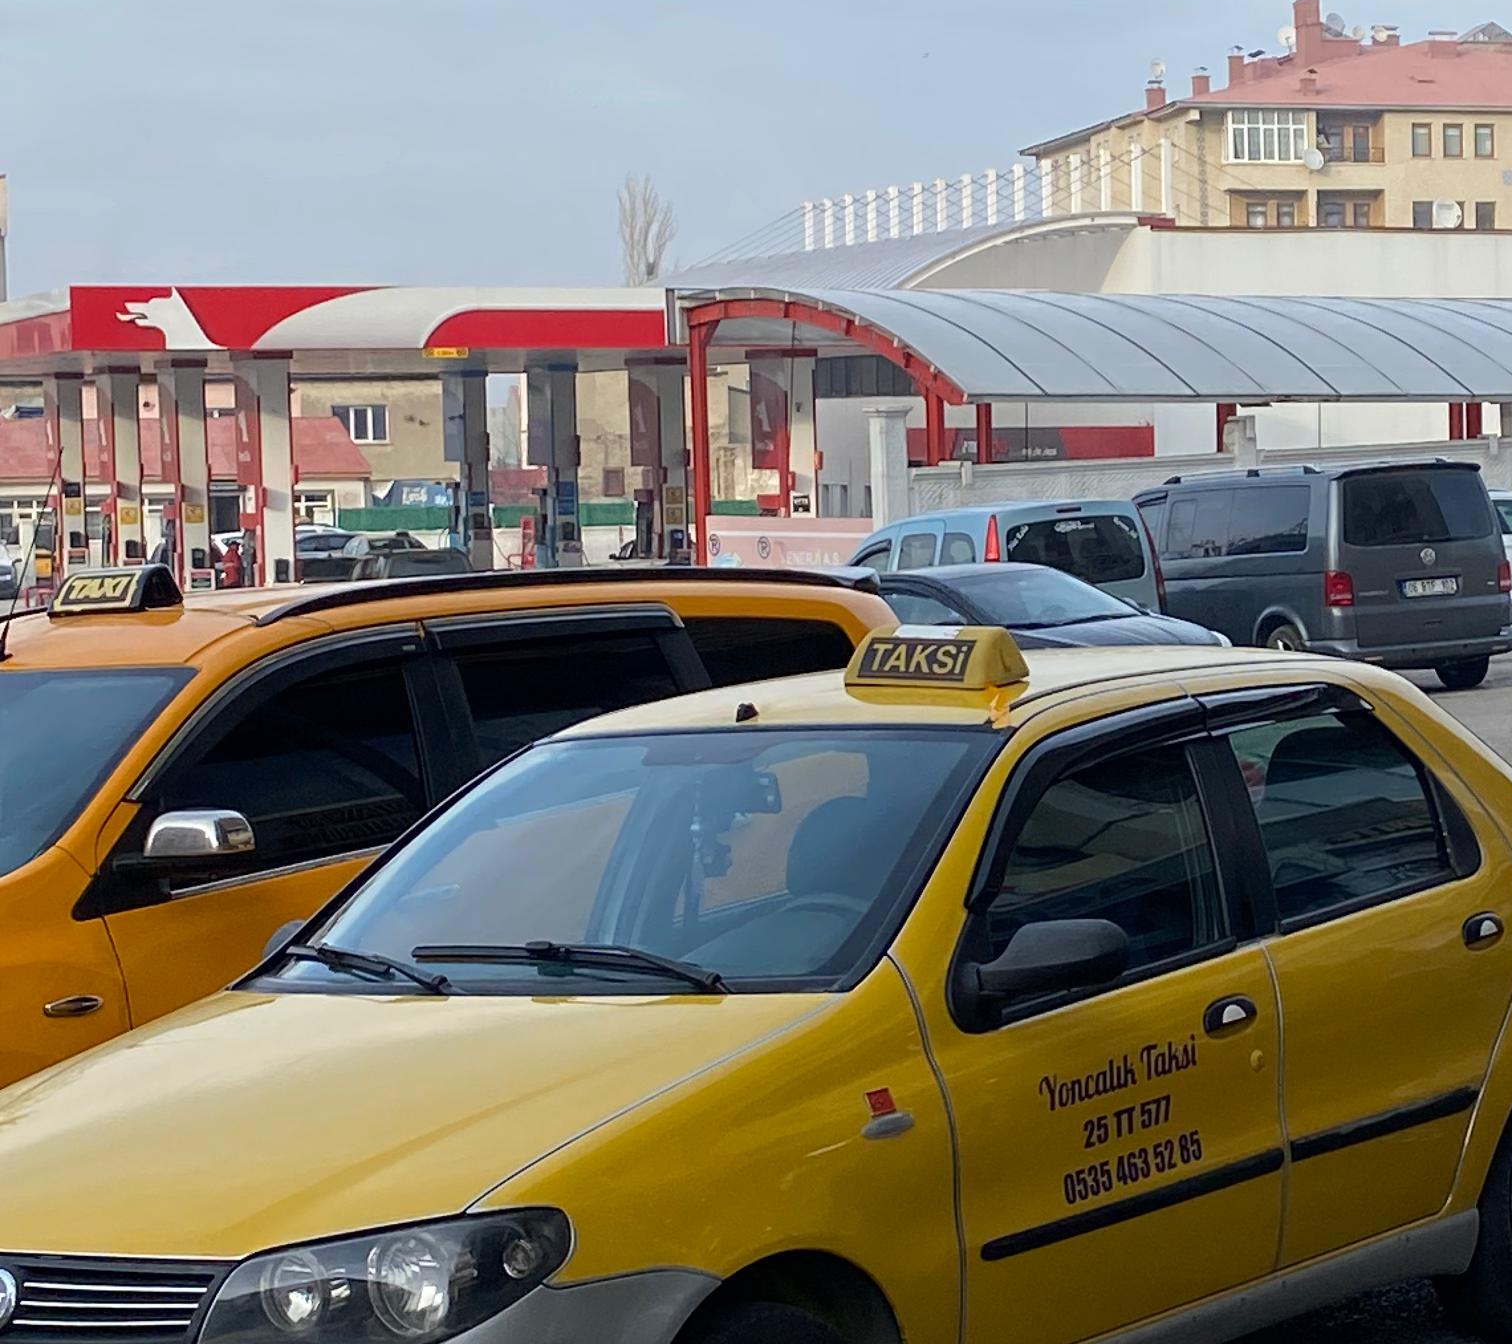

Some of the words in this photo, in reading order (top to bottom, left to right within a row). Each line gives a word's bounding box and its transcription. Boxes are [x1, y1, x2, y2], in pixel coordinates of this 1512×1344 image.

[70, 576, 130, 599] TAXI
[1039, 1054, 1138, 1111] Yoncalık
[1140, 1033, 1197, 1081] Taksi
[1083, 1115, 1109, 1149] 25
[1113, 1106, 1136, 1138] TT
[1140, 1094, 1171, 1130] 577
[1063, 1160, 1114, 1205] 0535
[1116, 1147, 1151, 1185] 463
[1153, 1139, 1177, 1173] 52
[1178, 1130, 1203, 1164] 85
